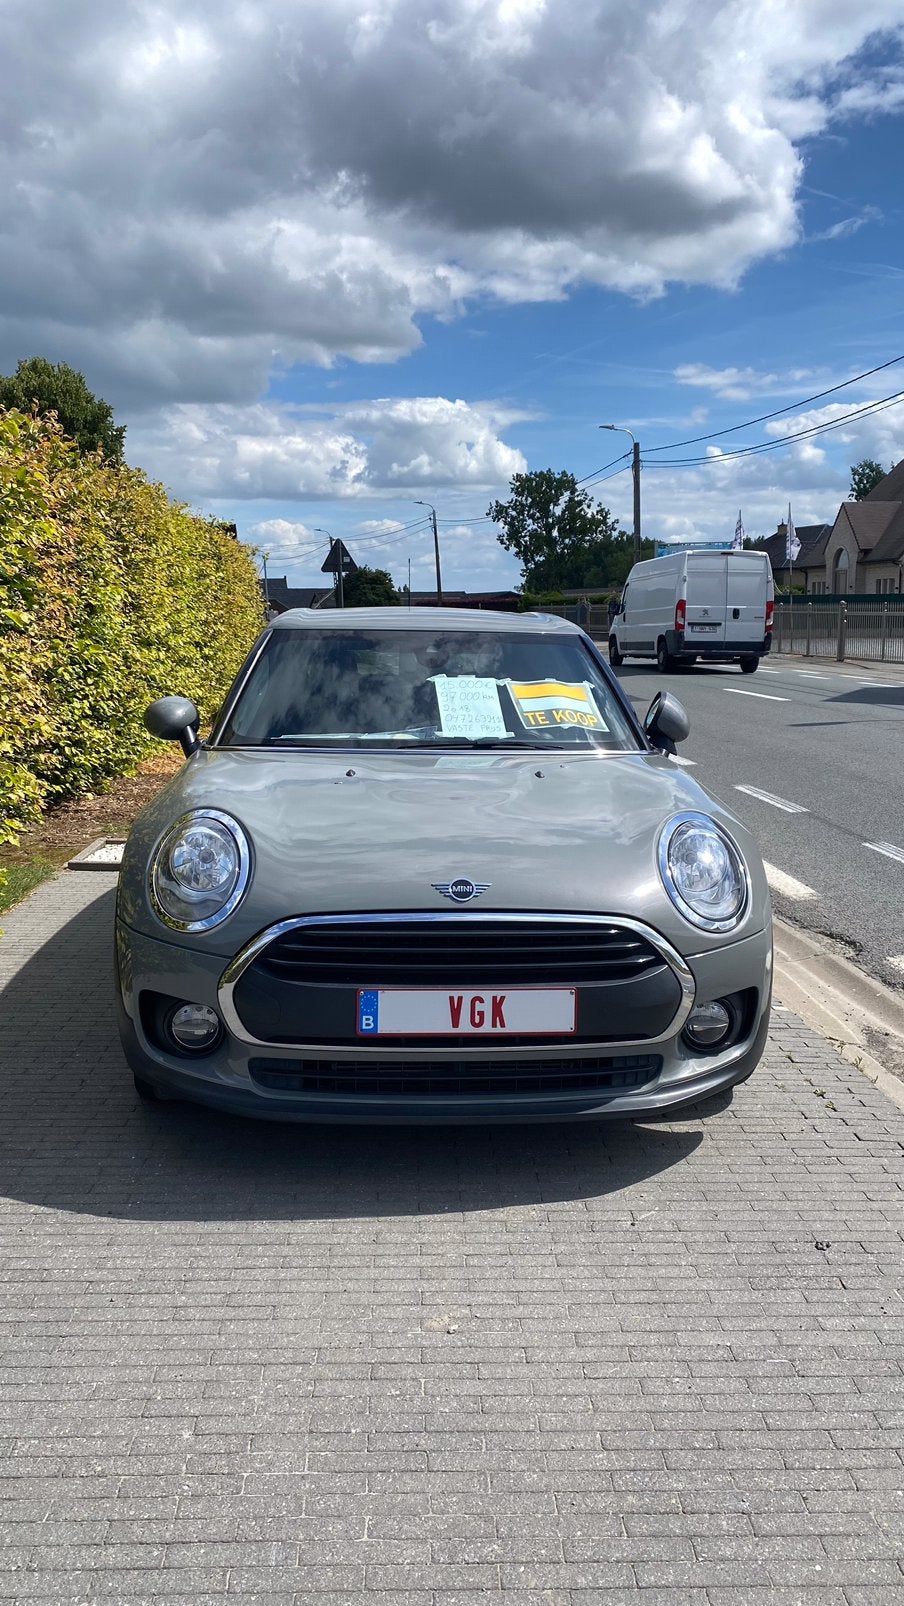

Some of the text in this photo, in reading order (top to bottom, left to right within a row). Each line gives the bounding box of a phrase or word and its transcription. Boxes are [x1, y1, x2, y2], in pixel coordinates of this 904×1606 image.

[523, 710, 598, 727] TE KOOP
[447, 724, 474, 733] VASTE
[452, 885, 473, 893] MINI
[448, 995, 506, 1029] VGK
[362, 1015, 374, 1030] B
